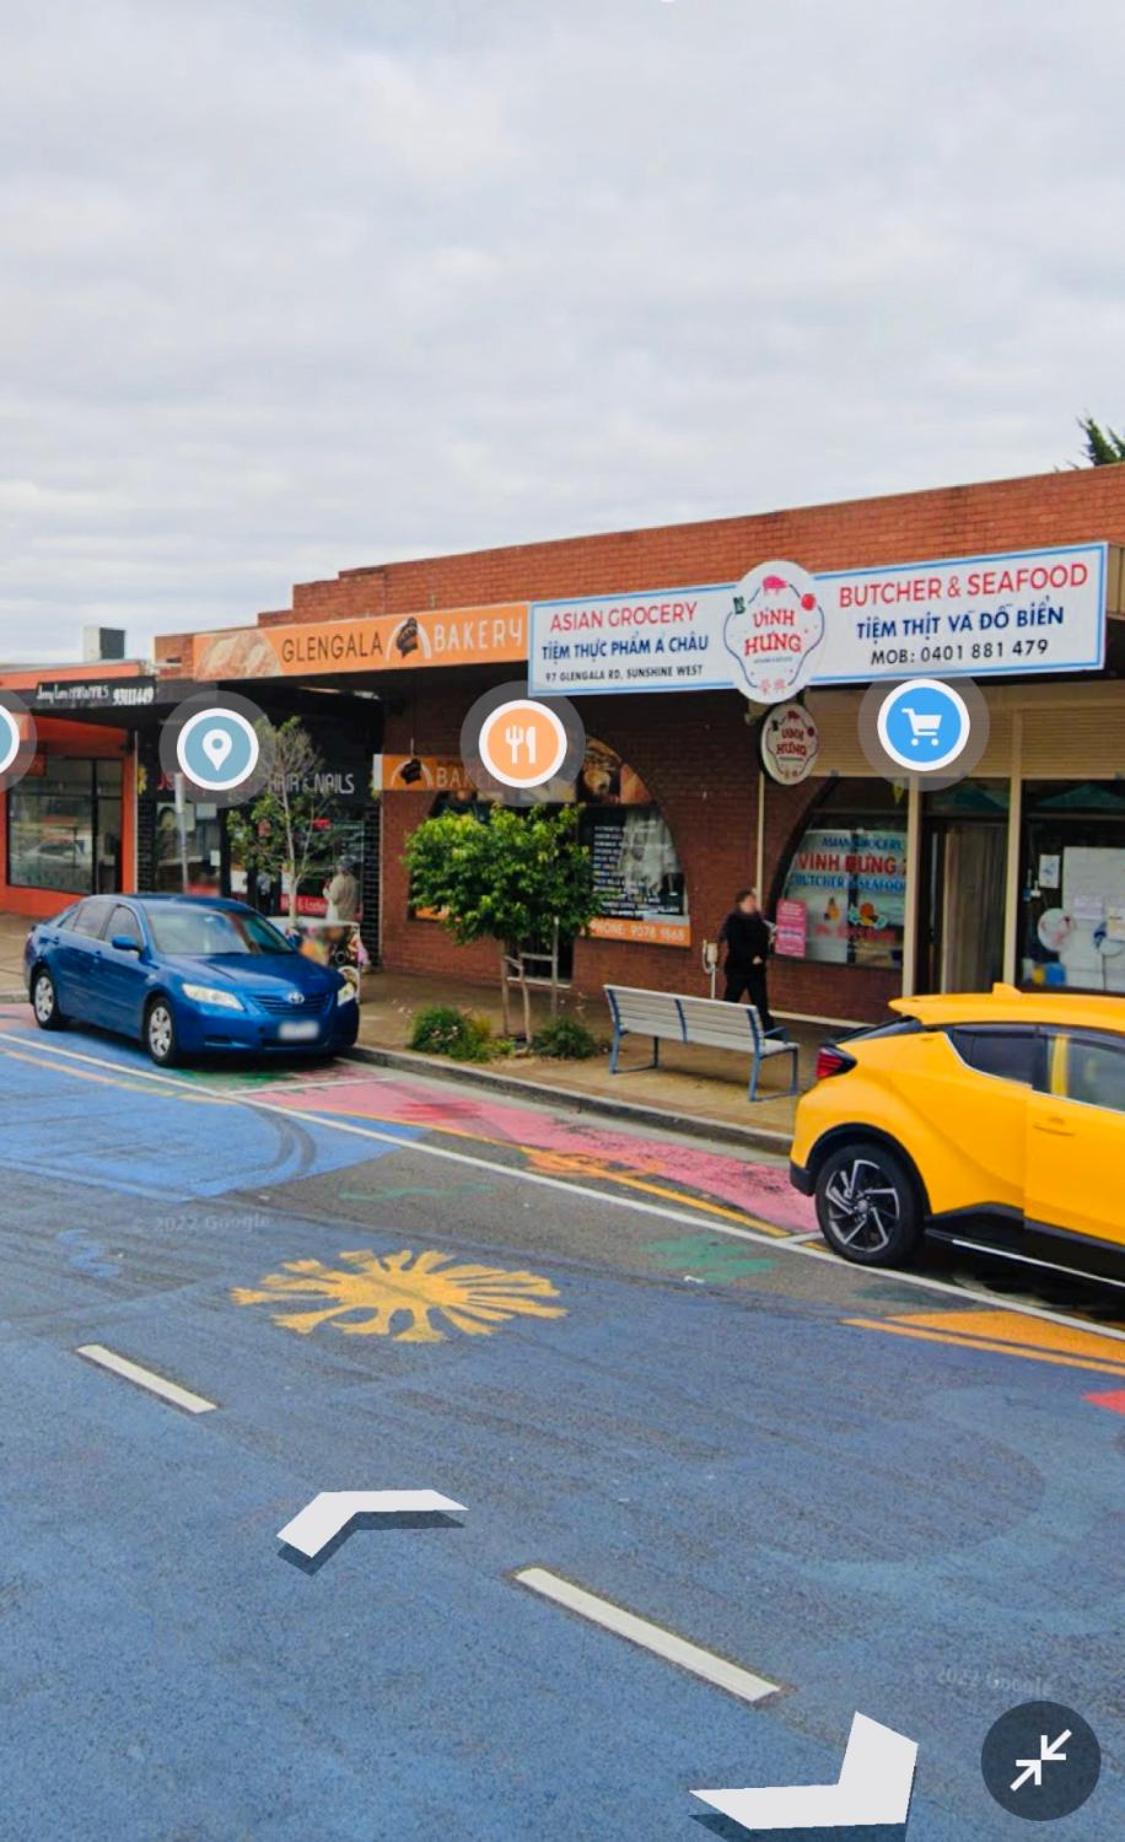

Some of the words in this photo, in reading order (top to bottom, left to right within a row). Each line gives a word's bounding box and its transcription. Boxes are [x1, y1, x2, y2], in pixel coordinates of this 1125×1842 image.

[839, 578, 942, 608] BUTCHER
[947, 576, 962, 598] &
[967, 563, 1089, 596] SEAFOOD
[550, 610, 603, 632] ASIAN
[608, 602, 698, 627] GROCERY
[281, 631, 384, 663] GLENGALA
[433, 617, 523, 653] BAKERY
[871, 648, 915, 666] MOB:
[920, 645, 963, 662] 0401
[971, 642, 1004, 659] 881
[1012, 639, 1049, 656] 479
[545, 672, 557, 683] 97
[560, 669, 605, 682] GLENGALA
[626, 665, 672, 679] SUNSHINE
[676, 664, 703, 676] WEST
[313, 772, 356, 794] NAILS
[798, 853, 840, 871] VINH
